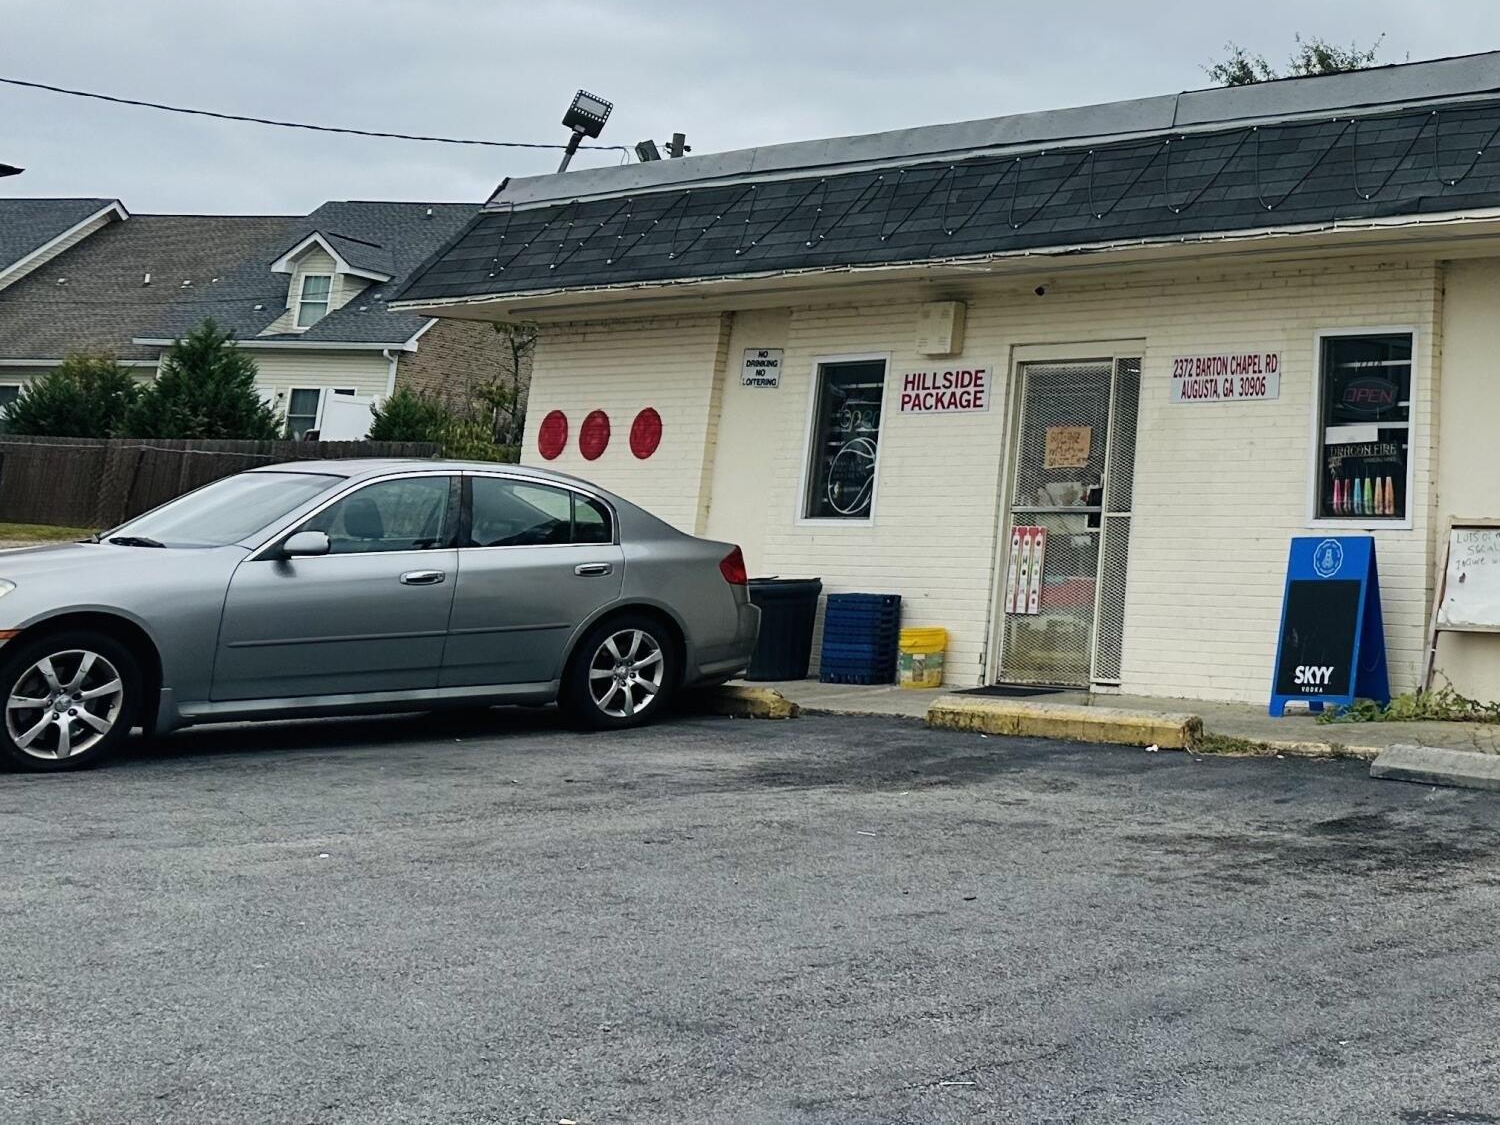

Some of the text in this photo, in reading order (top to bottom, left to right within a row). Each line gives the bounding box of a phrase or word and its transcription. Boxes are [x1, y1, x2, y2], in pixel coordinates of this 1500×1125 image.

[758, 350, 769, 358] NO
[756, 369, 766, 377] NO
[1173, 354, 1278, 378] 2372 BARTON CHAPEL RD
[742, 378, 777, 386] LOITERING
[904, 370, 986, 391] HILLSIDE
[1181, 376, 1266, 399] AUGUSTA, GA 30906
[901, 390, 984, 411] PACKAGE
[1343, 387, 1393, 403] OPEN
[1294, 665, 1334, 684] SKYY
